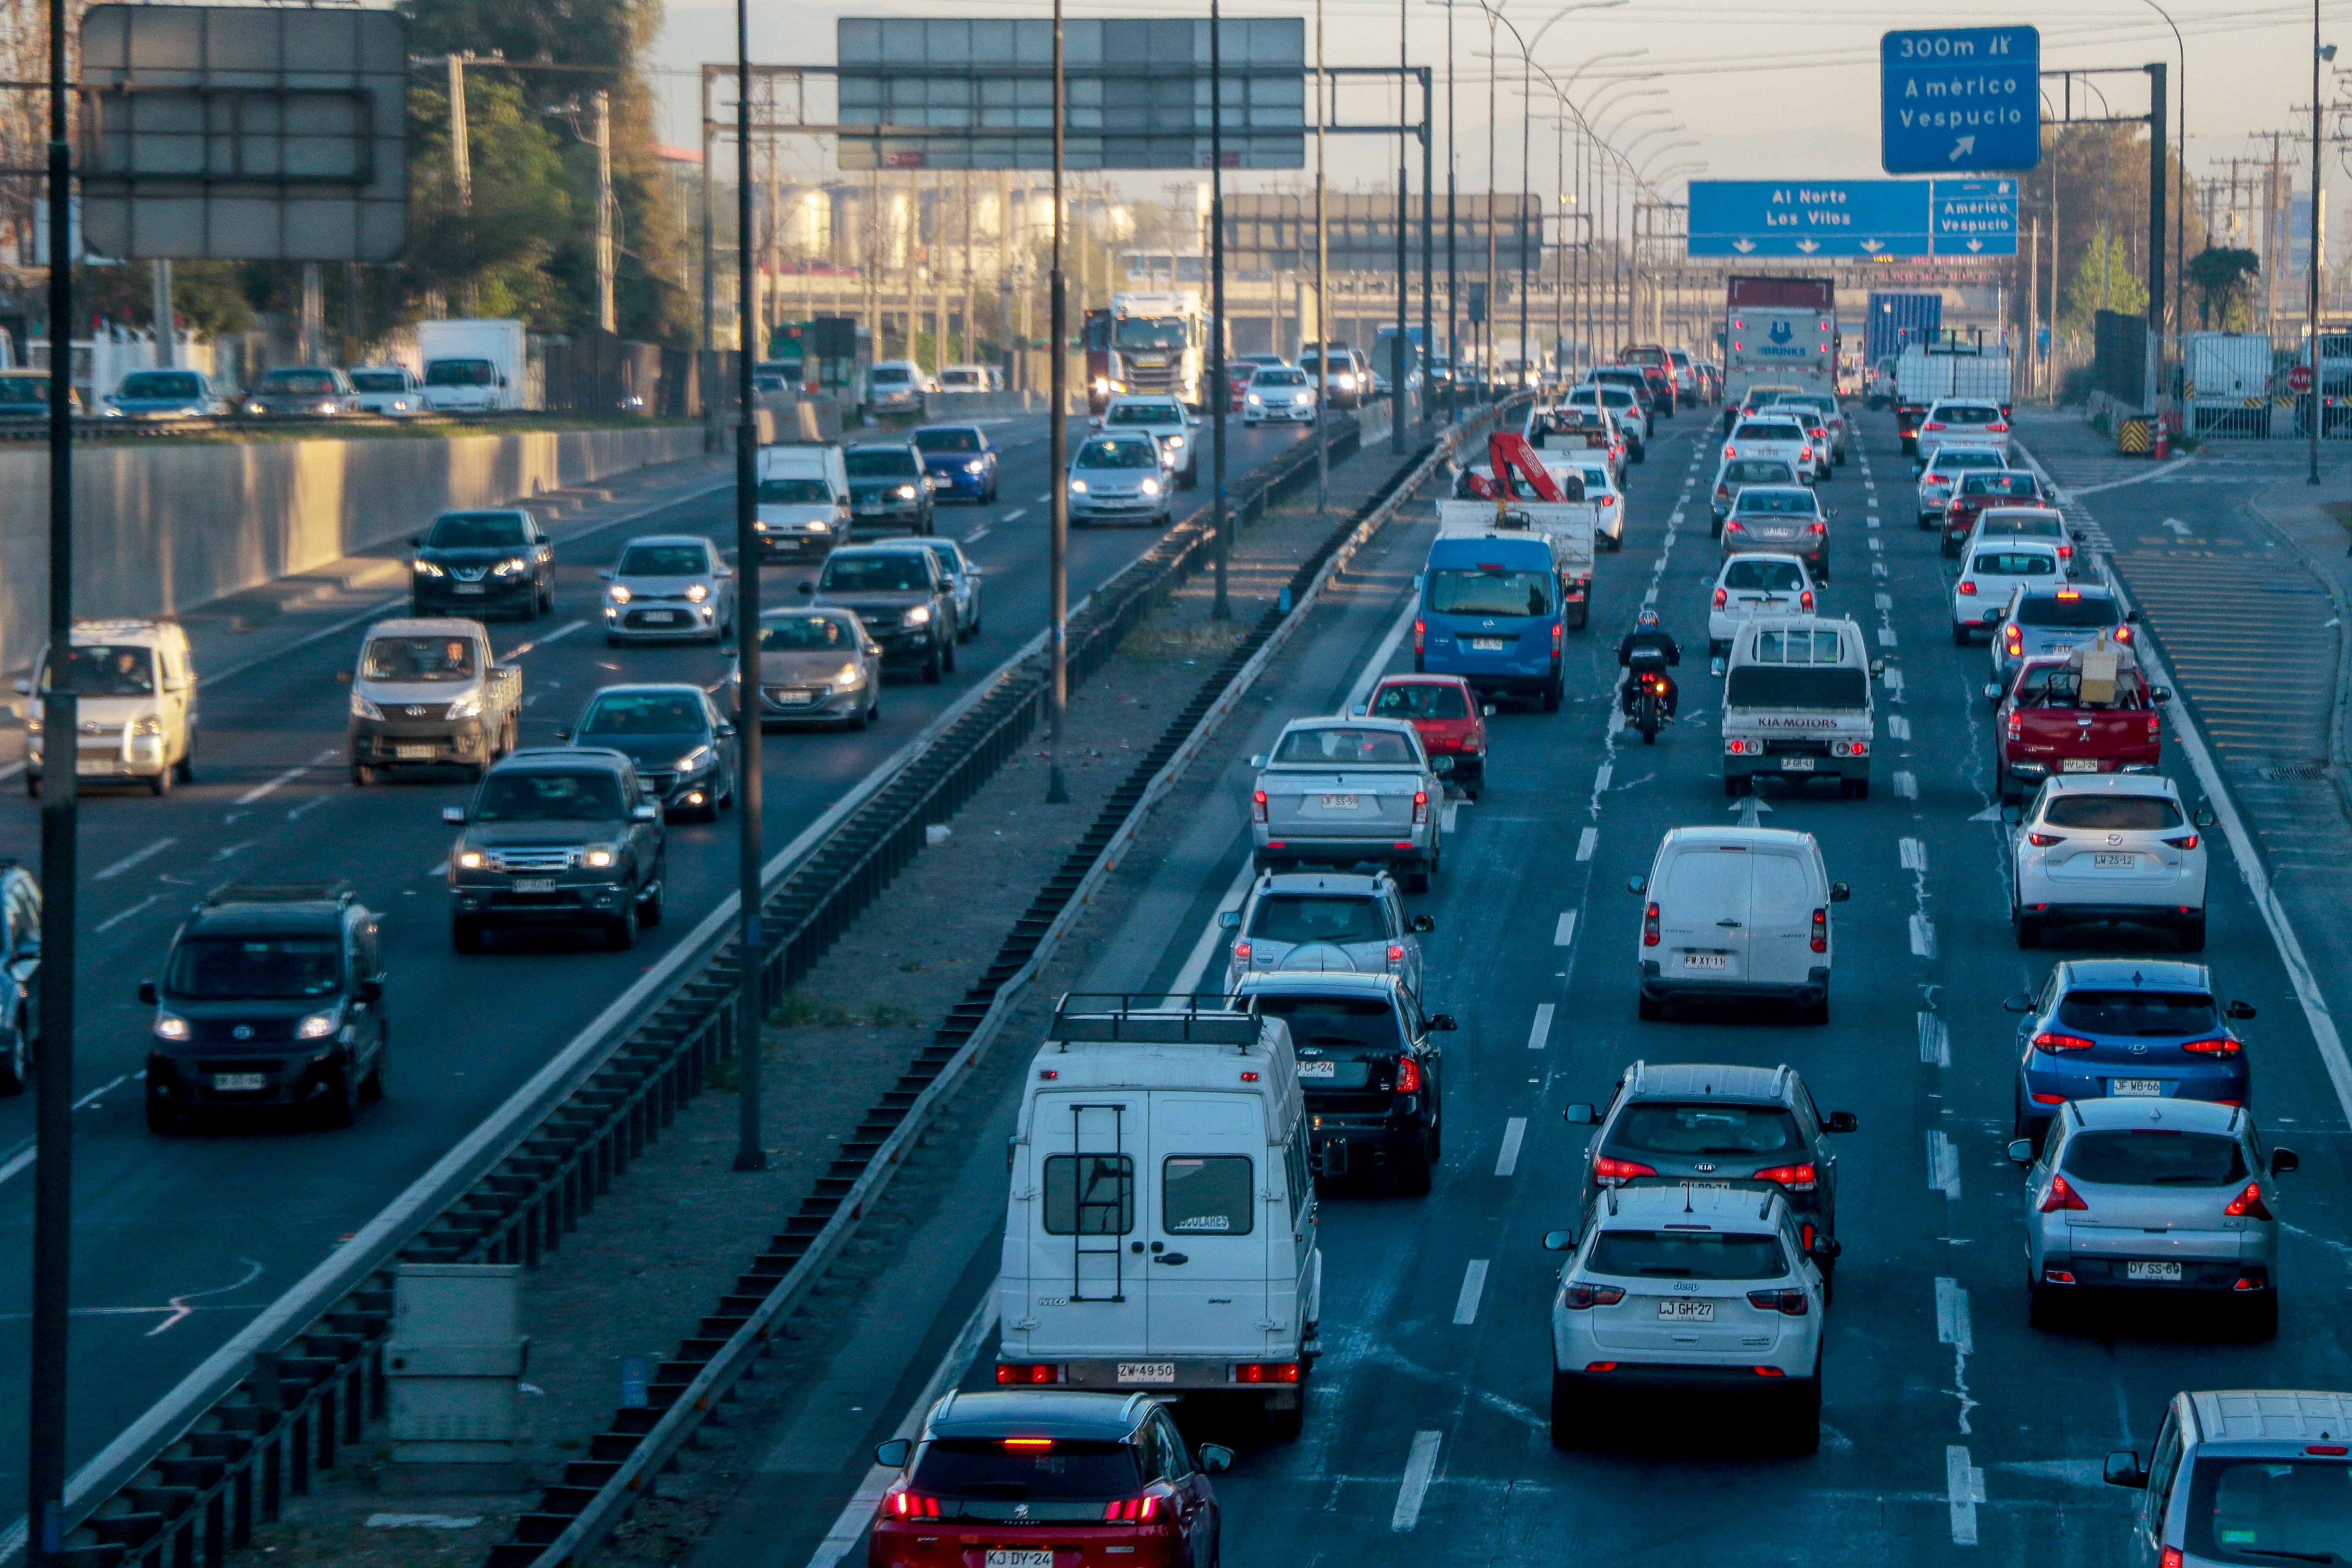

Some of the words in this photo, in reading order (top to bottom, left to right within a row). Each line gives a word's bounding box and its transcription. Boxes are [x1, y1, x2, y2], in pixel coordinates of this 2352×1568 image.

[1900, 37, 1974, 57] 300m
[1905, 74, 2017, 97] Américo
[1900, 106, 2021, 130] Vespucio
[1772, 189, 1792, 204] Al
[1800, 189, 1846, 204] Norte
[1766, 209, 1798, 226] Los
[1807, 210, 1851, 226] Vilos
[1942, 218, 2009, 232] Vespucio
[1758, 717, 1780, 727] KIA
[1784, 717, 1837, 728] MOTORS
[1674, 1281, 1699, 1292] Jeep
